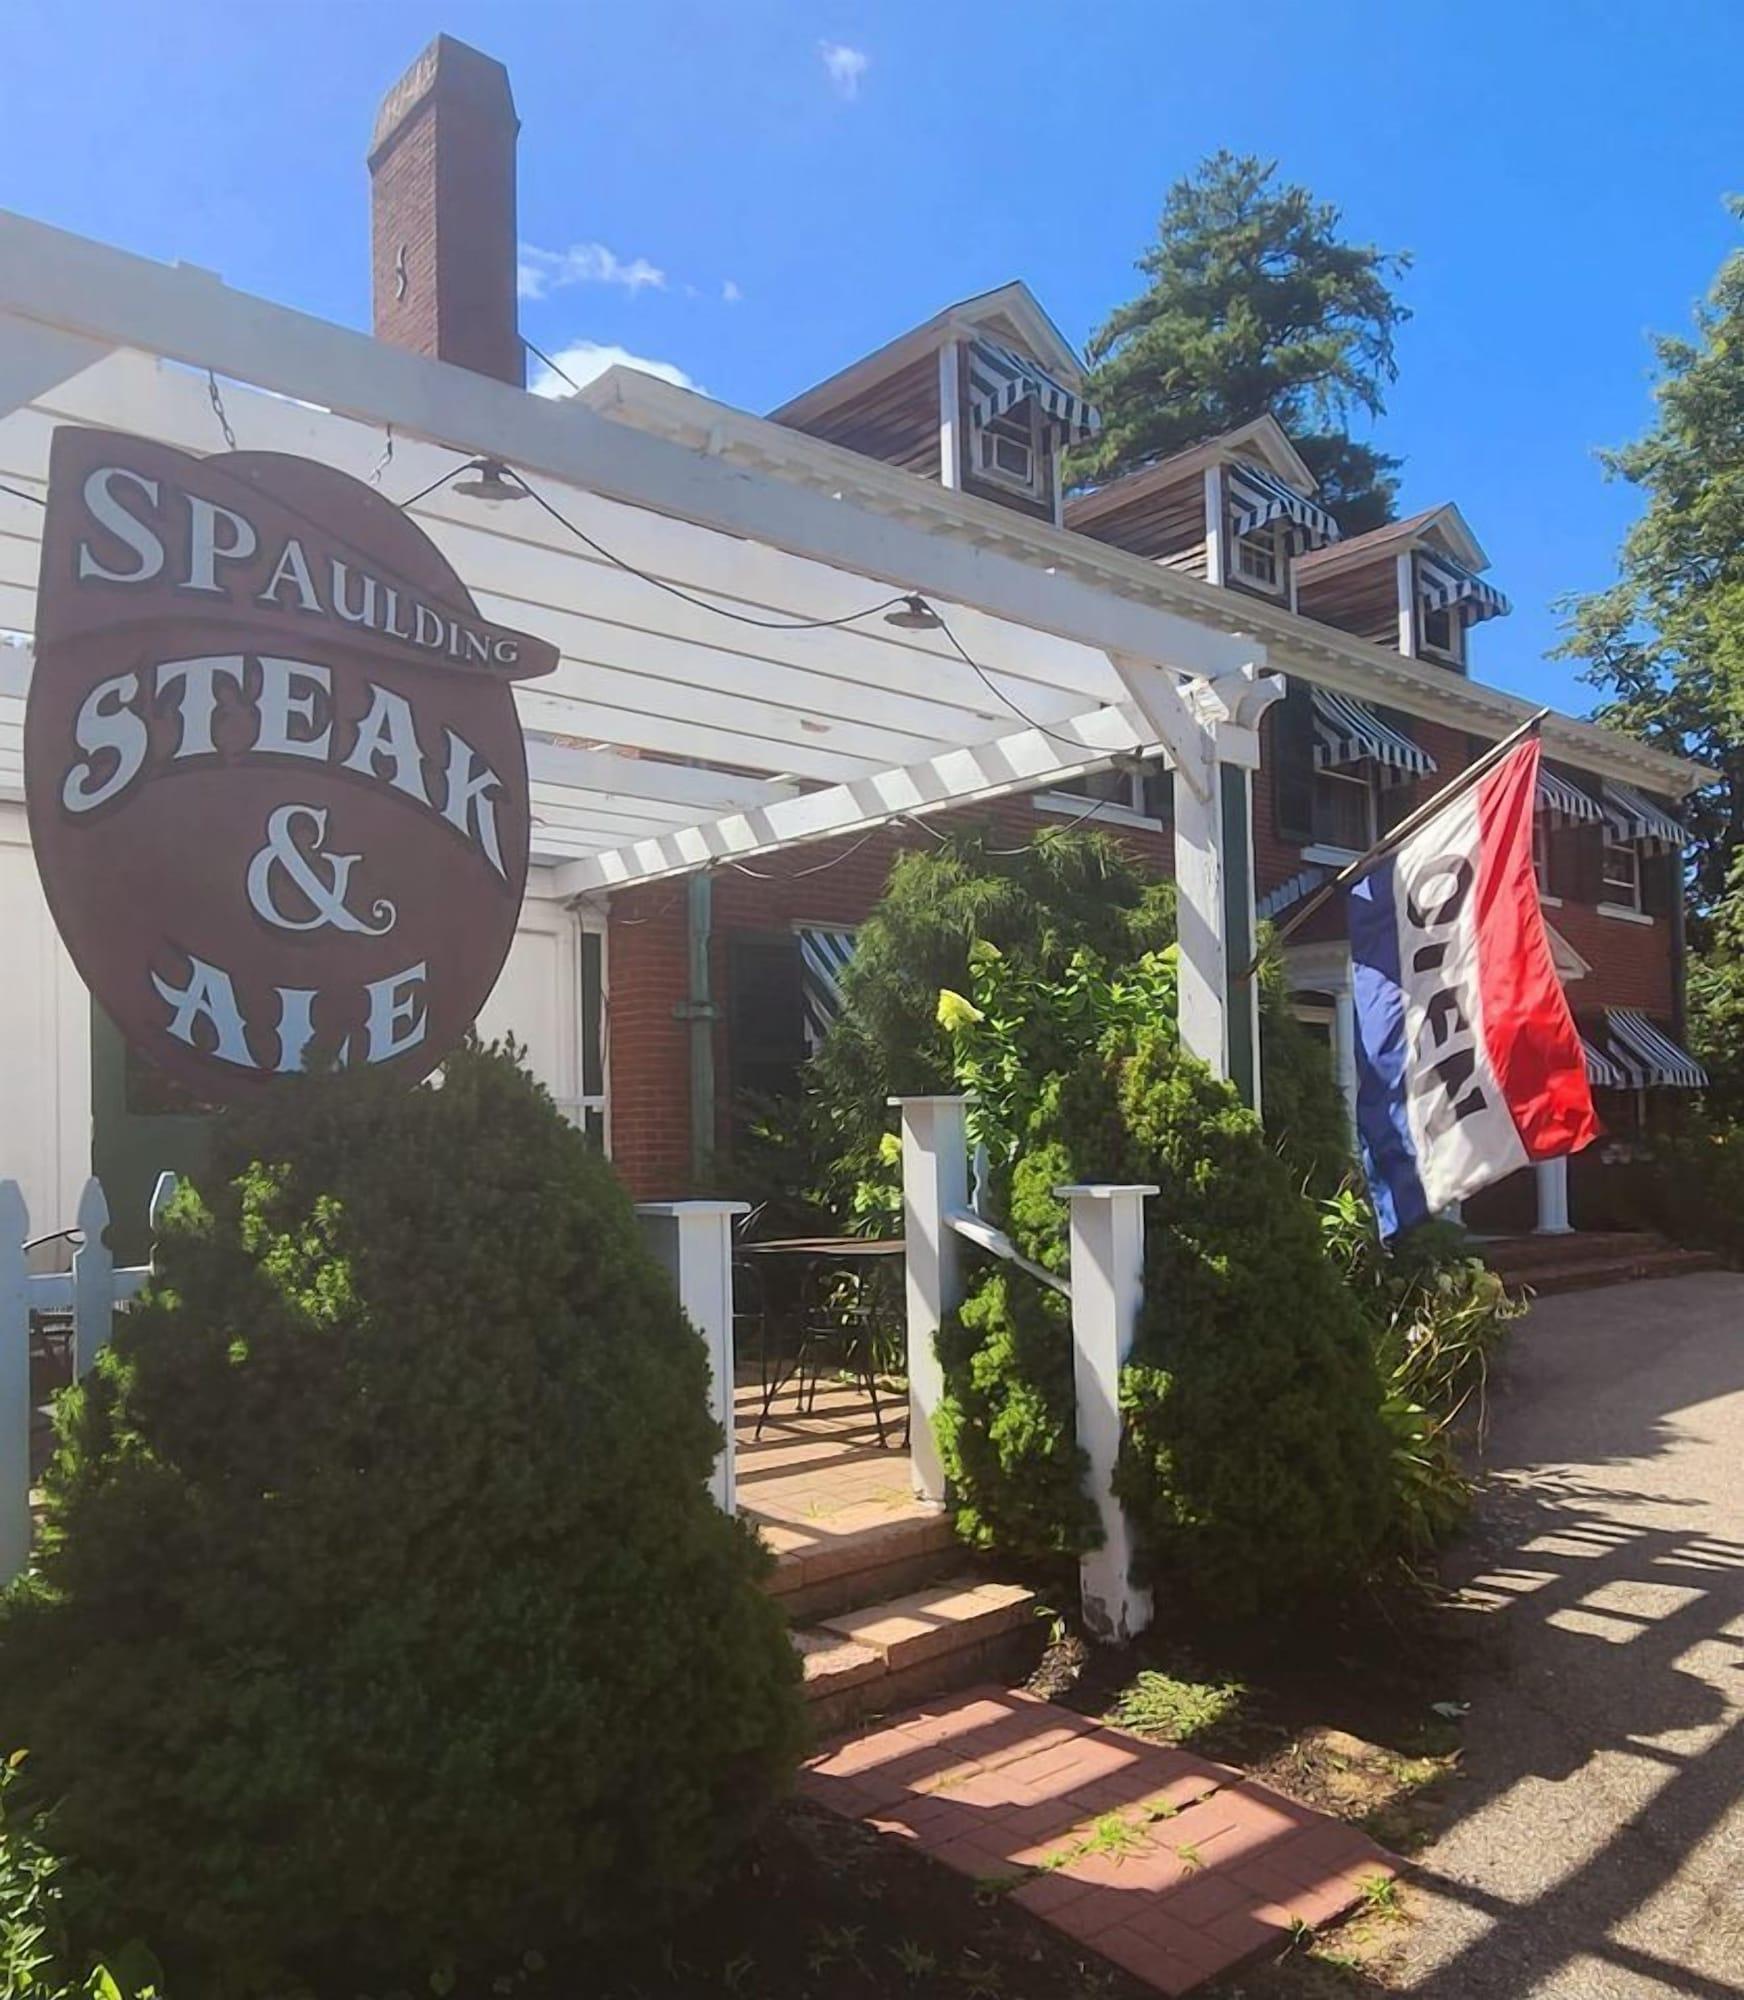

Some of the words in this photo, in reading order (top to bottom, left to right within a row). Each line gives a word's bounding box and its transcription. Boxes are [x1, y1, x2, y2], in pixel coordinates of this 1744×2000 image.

[79, 468, 519, 663] SPAULDING
[62, 655, 508, 880] STEAK
[247, 804, 397, 935] &
[151, 954, 429, 1072] ALE
